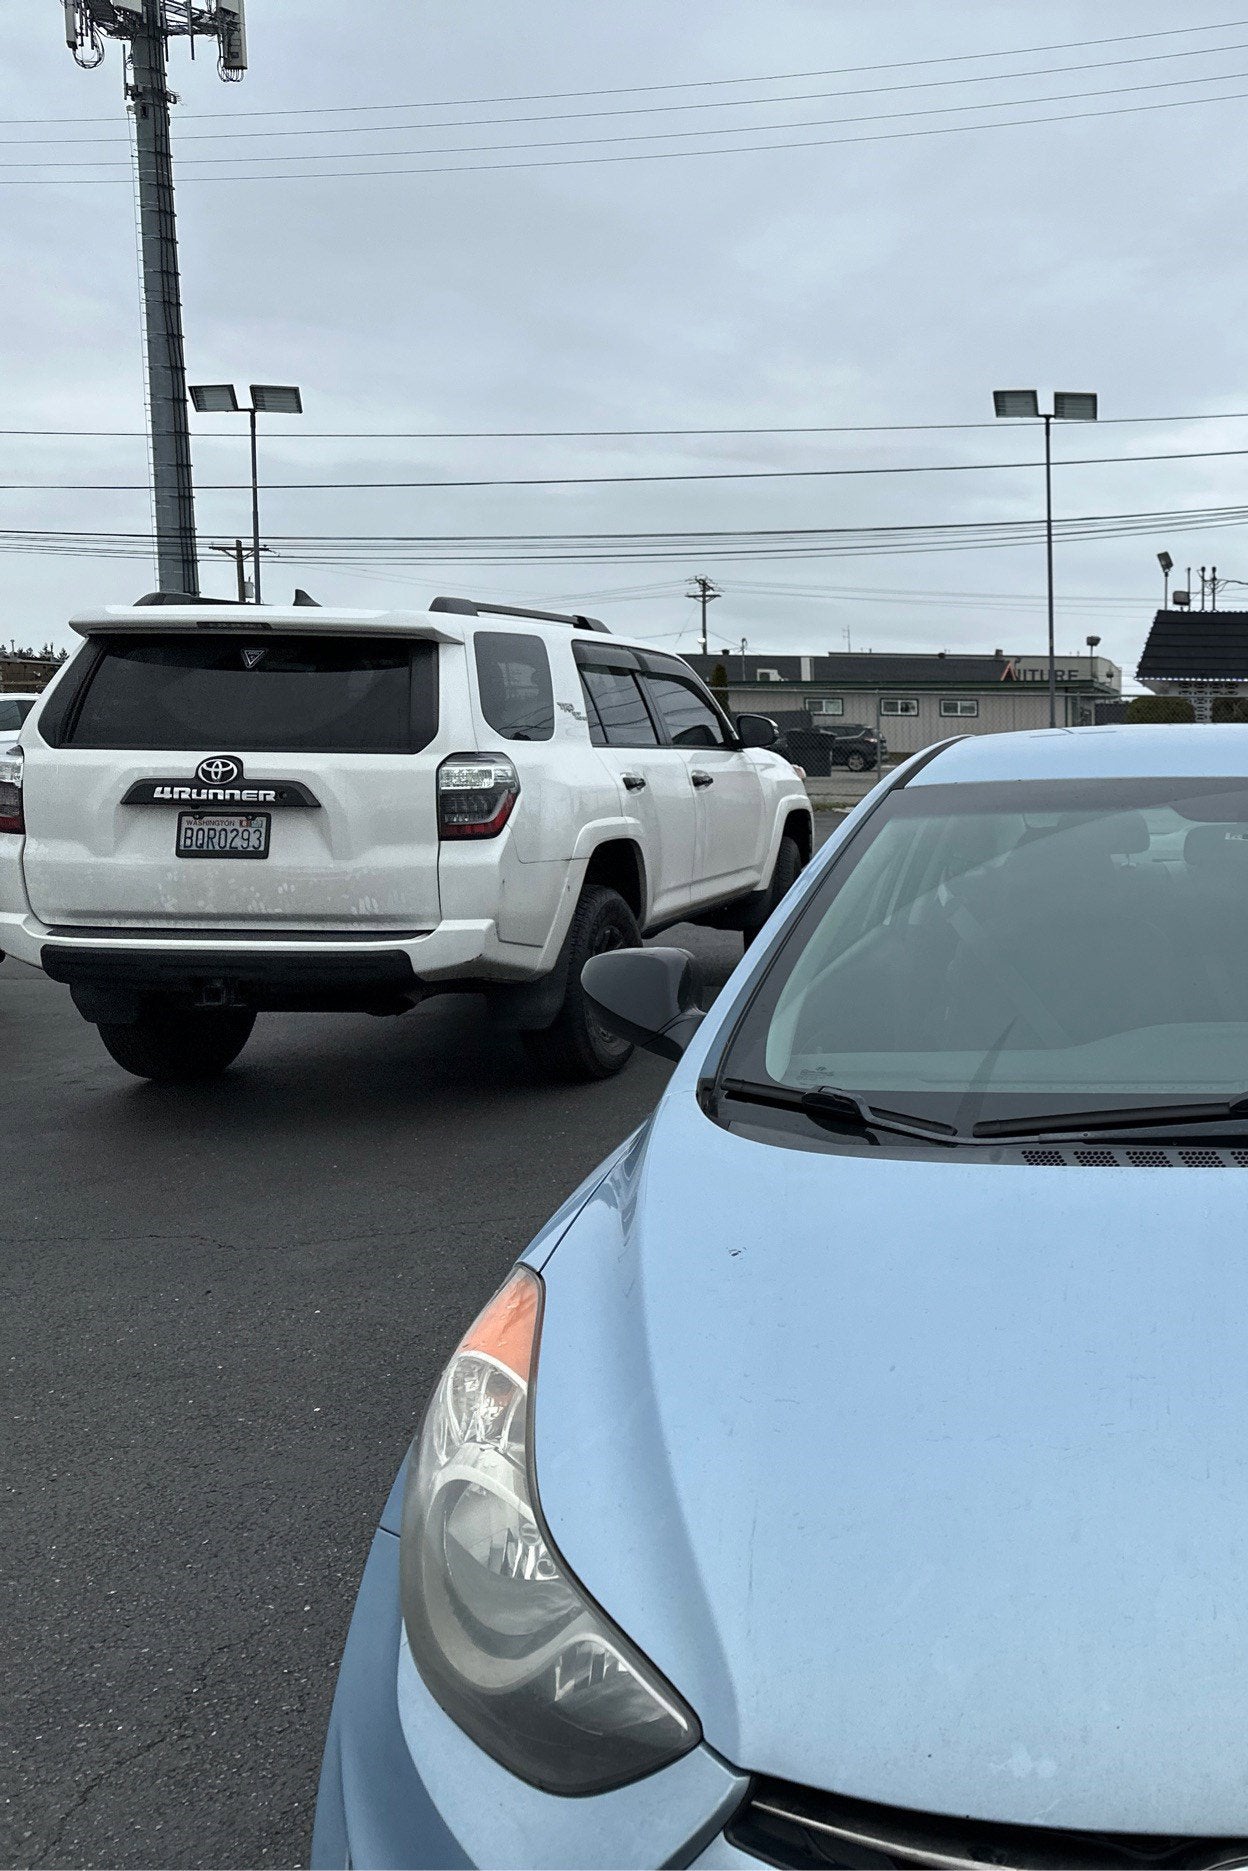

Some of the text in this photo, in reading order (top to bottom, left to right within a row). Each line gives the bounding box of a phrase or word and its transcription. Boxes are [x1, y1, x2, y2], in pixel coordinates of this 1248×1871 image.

[153, 786, 276, 802] 4RUNNER
[186, 819, 235, 827] WASHINGTON
[183, 827, 262, 850] BQR0293
